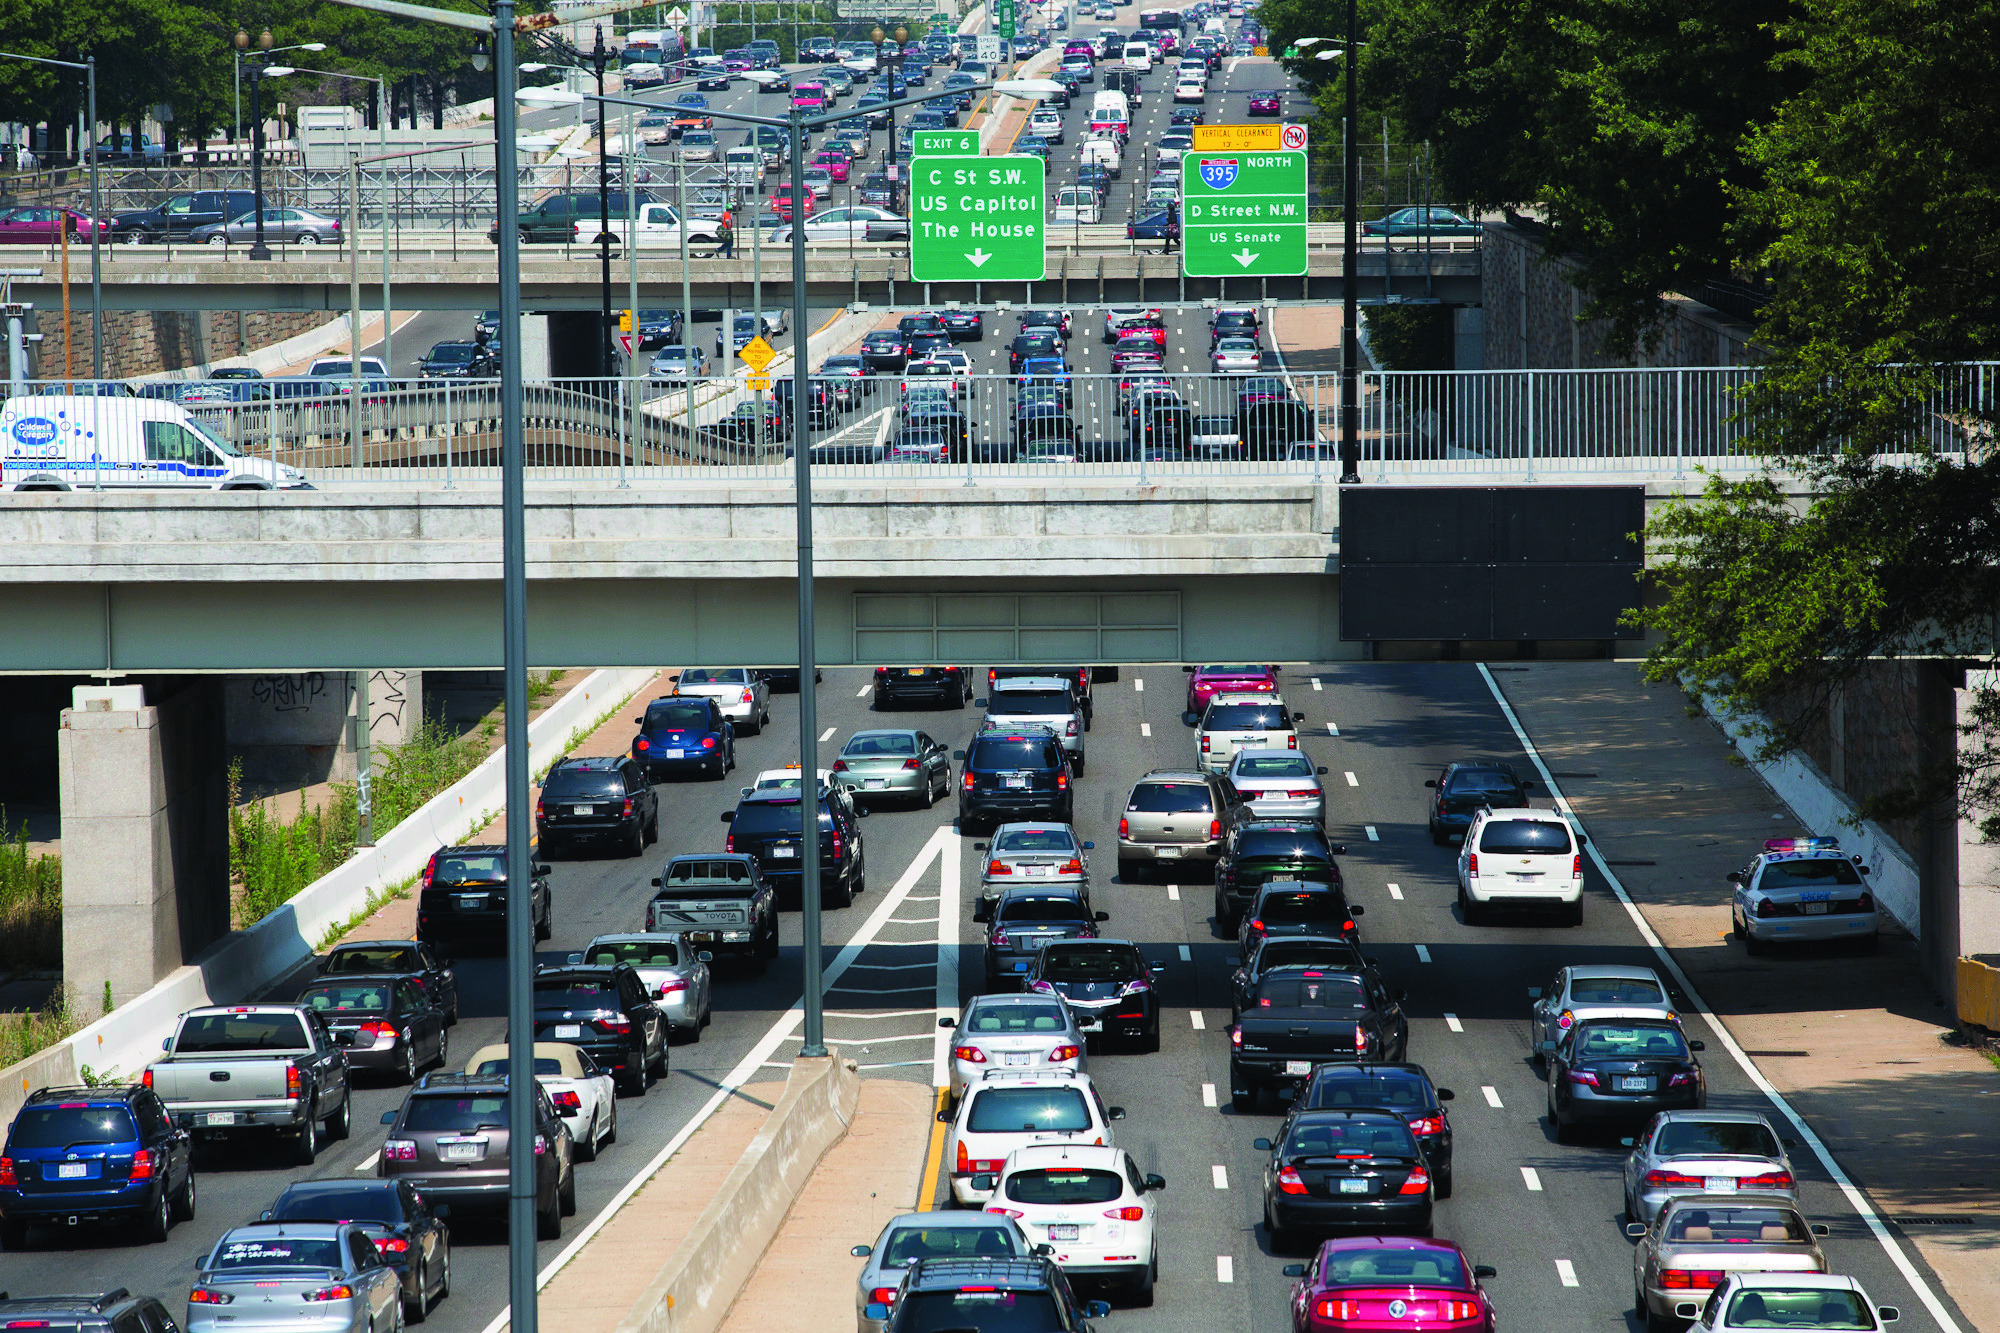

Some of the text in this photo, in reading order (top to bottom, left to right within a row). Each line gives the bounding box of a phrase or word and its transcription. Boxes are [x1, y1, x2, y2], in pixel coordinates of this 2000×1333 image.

[981, 52, 997, 60] 40
[1202, 129, 1272, 137] VERTICAL CLEARANCE
[924, 138, 969, 149] EXIT 6
[1247, 157, 1291, 167] NORTH
[929, 169, 1026, 185] C St S.W.
[1206, 167, 1233, 181] 395
[920, 195, 1036, 214] US Capitol
[1192, 204, 1299, 217] D Street N.W.
[921, 222, 1035, 238] The House
[1210, 232, 1281, 243] US Senate
[22, 431, 54, 439] Gregory
